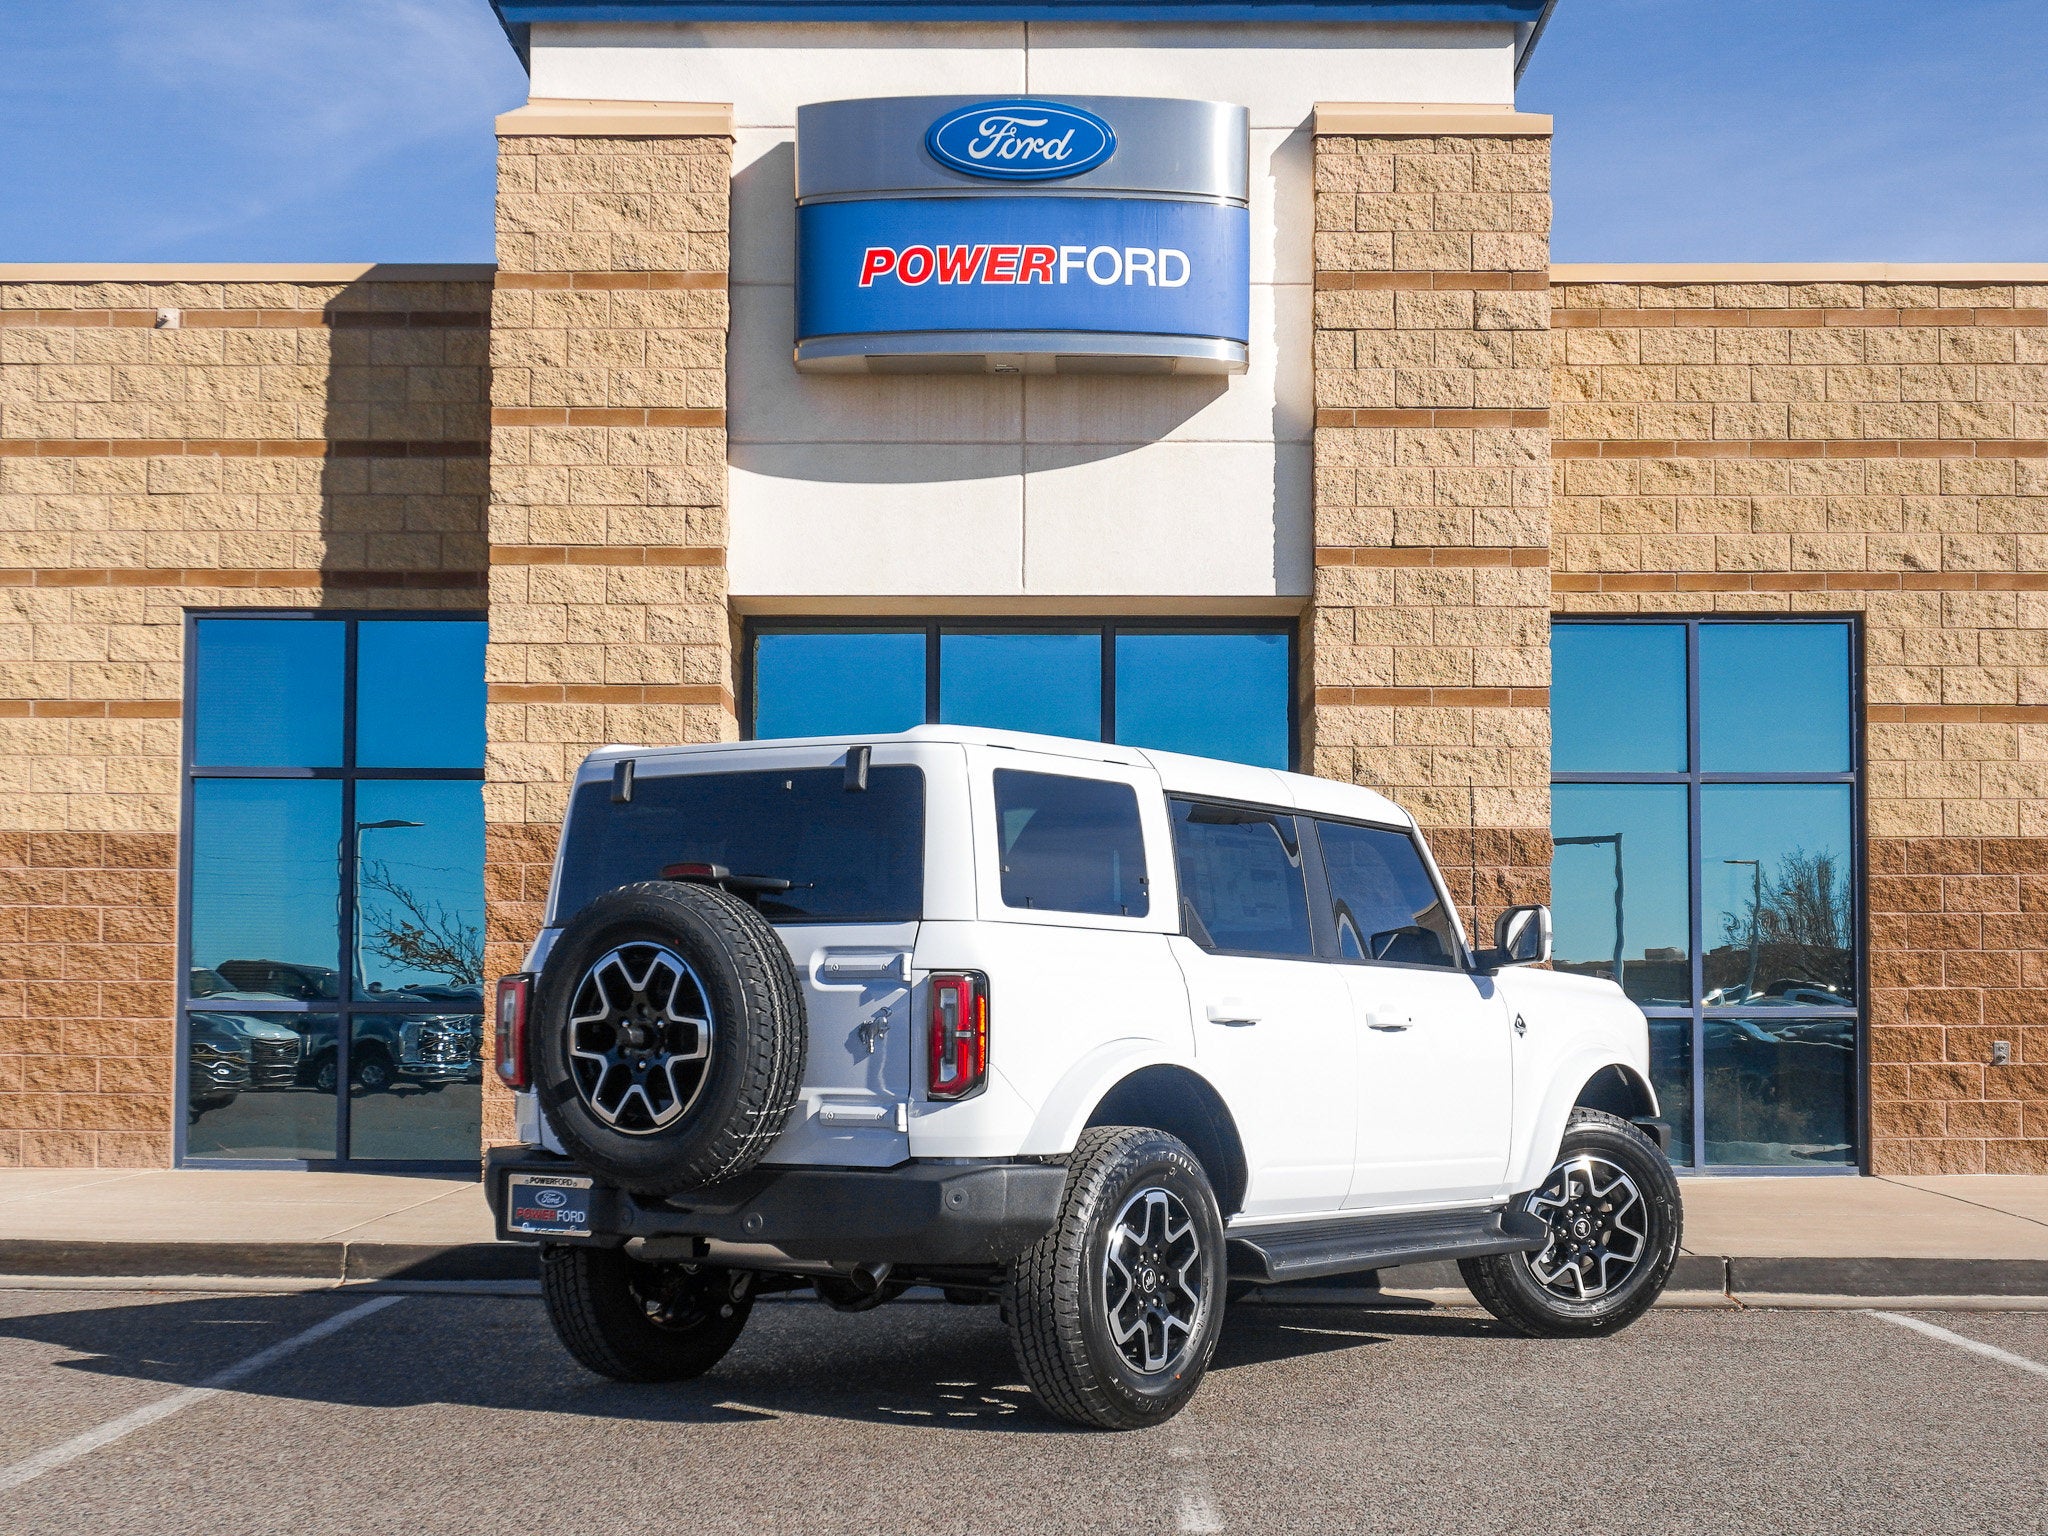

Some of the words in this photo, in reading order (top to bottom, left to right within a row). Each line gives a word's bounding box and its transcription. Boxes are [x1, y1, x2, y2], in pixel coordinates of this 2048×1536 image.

[968, 115, 1075, 161] Ford
[858, 244, 1192, 288] POWERFORD
[541, 1193, 561, 1204] Ford
